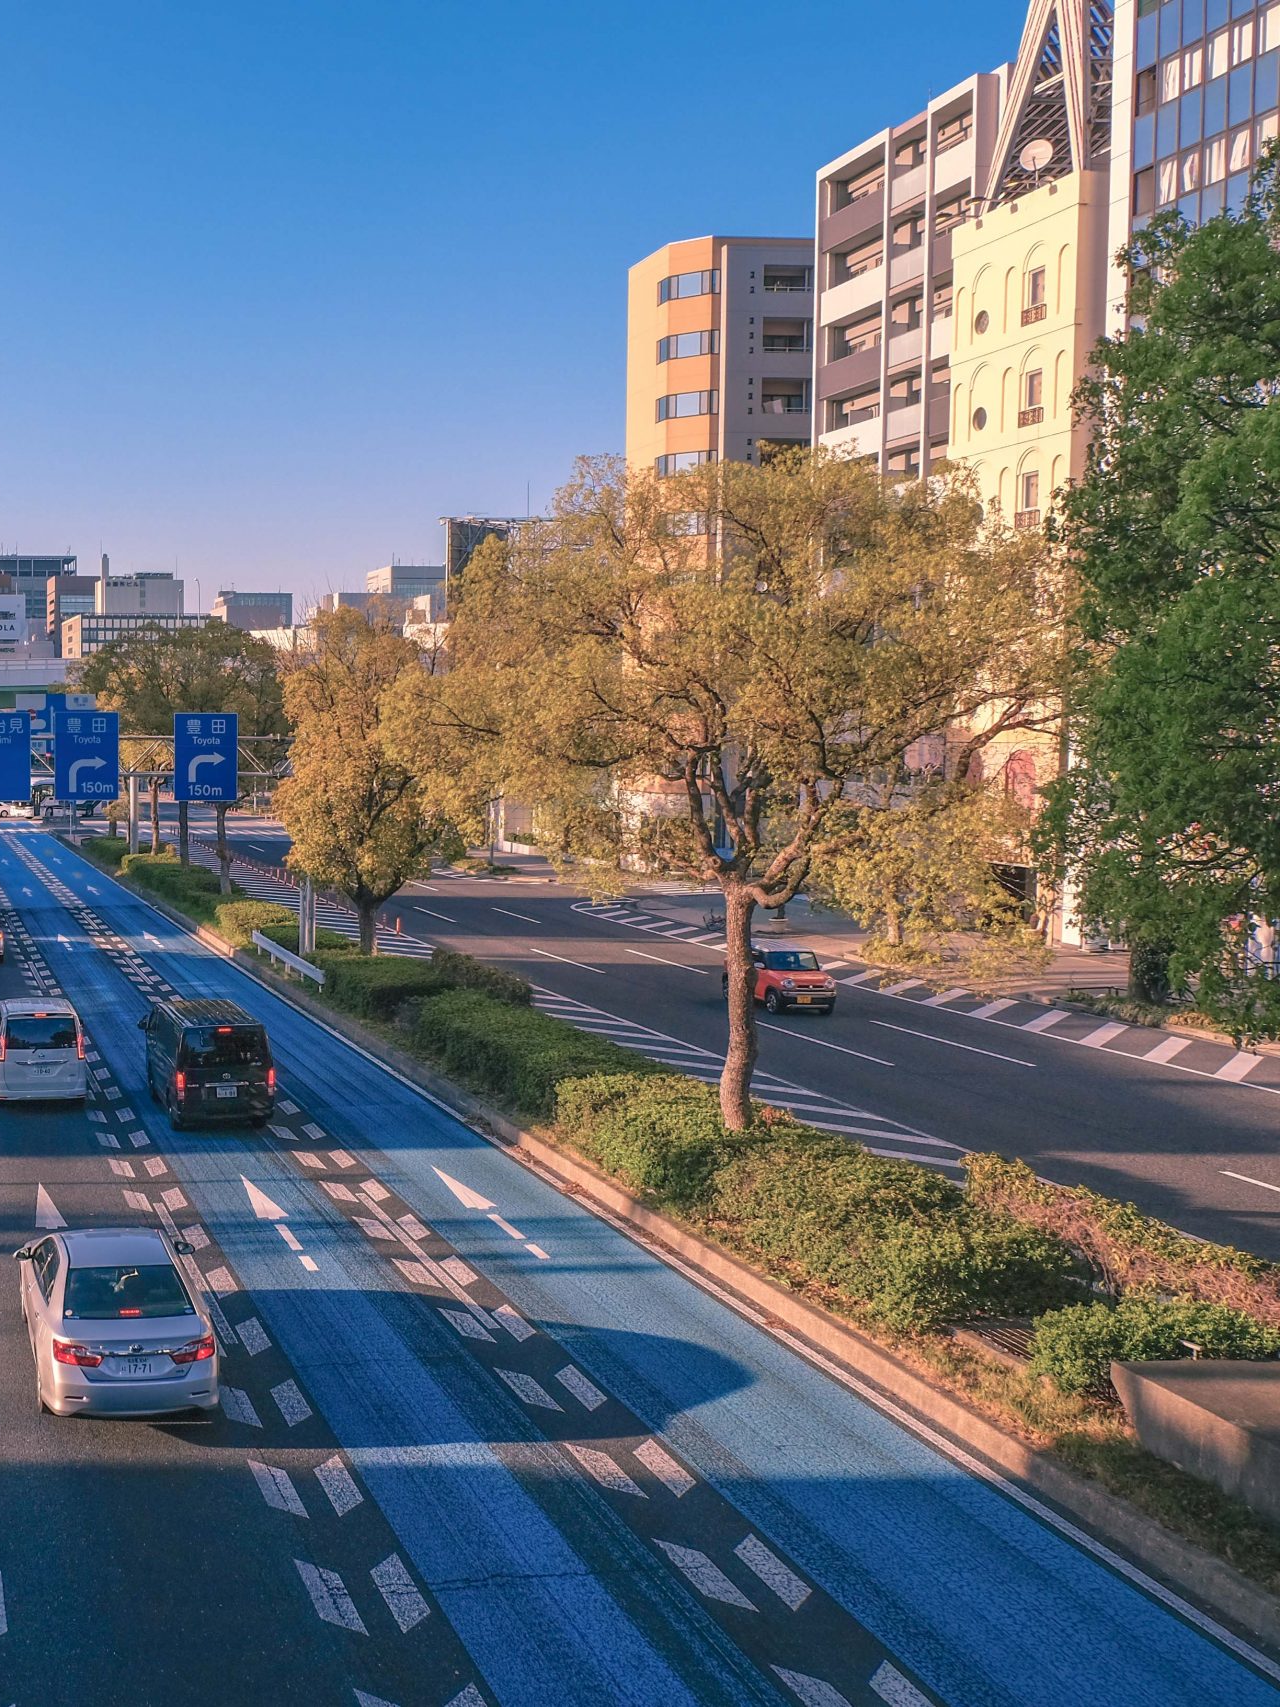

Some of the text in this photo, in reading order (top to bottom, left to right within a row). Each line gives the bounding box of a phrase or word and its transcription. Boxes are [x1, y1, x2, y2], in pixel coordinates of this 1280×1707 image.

[67, 718, 107, 733] 豊田
[186, 719, 226, 734] 豊田
[73, 735, 101, 745] Toyota
[192, 736, 221, 746] Toyota
[81, 782, 114, 793] 150m
[188, 785, 222, 796] 150m
